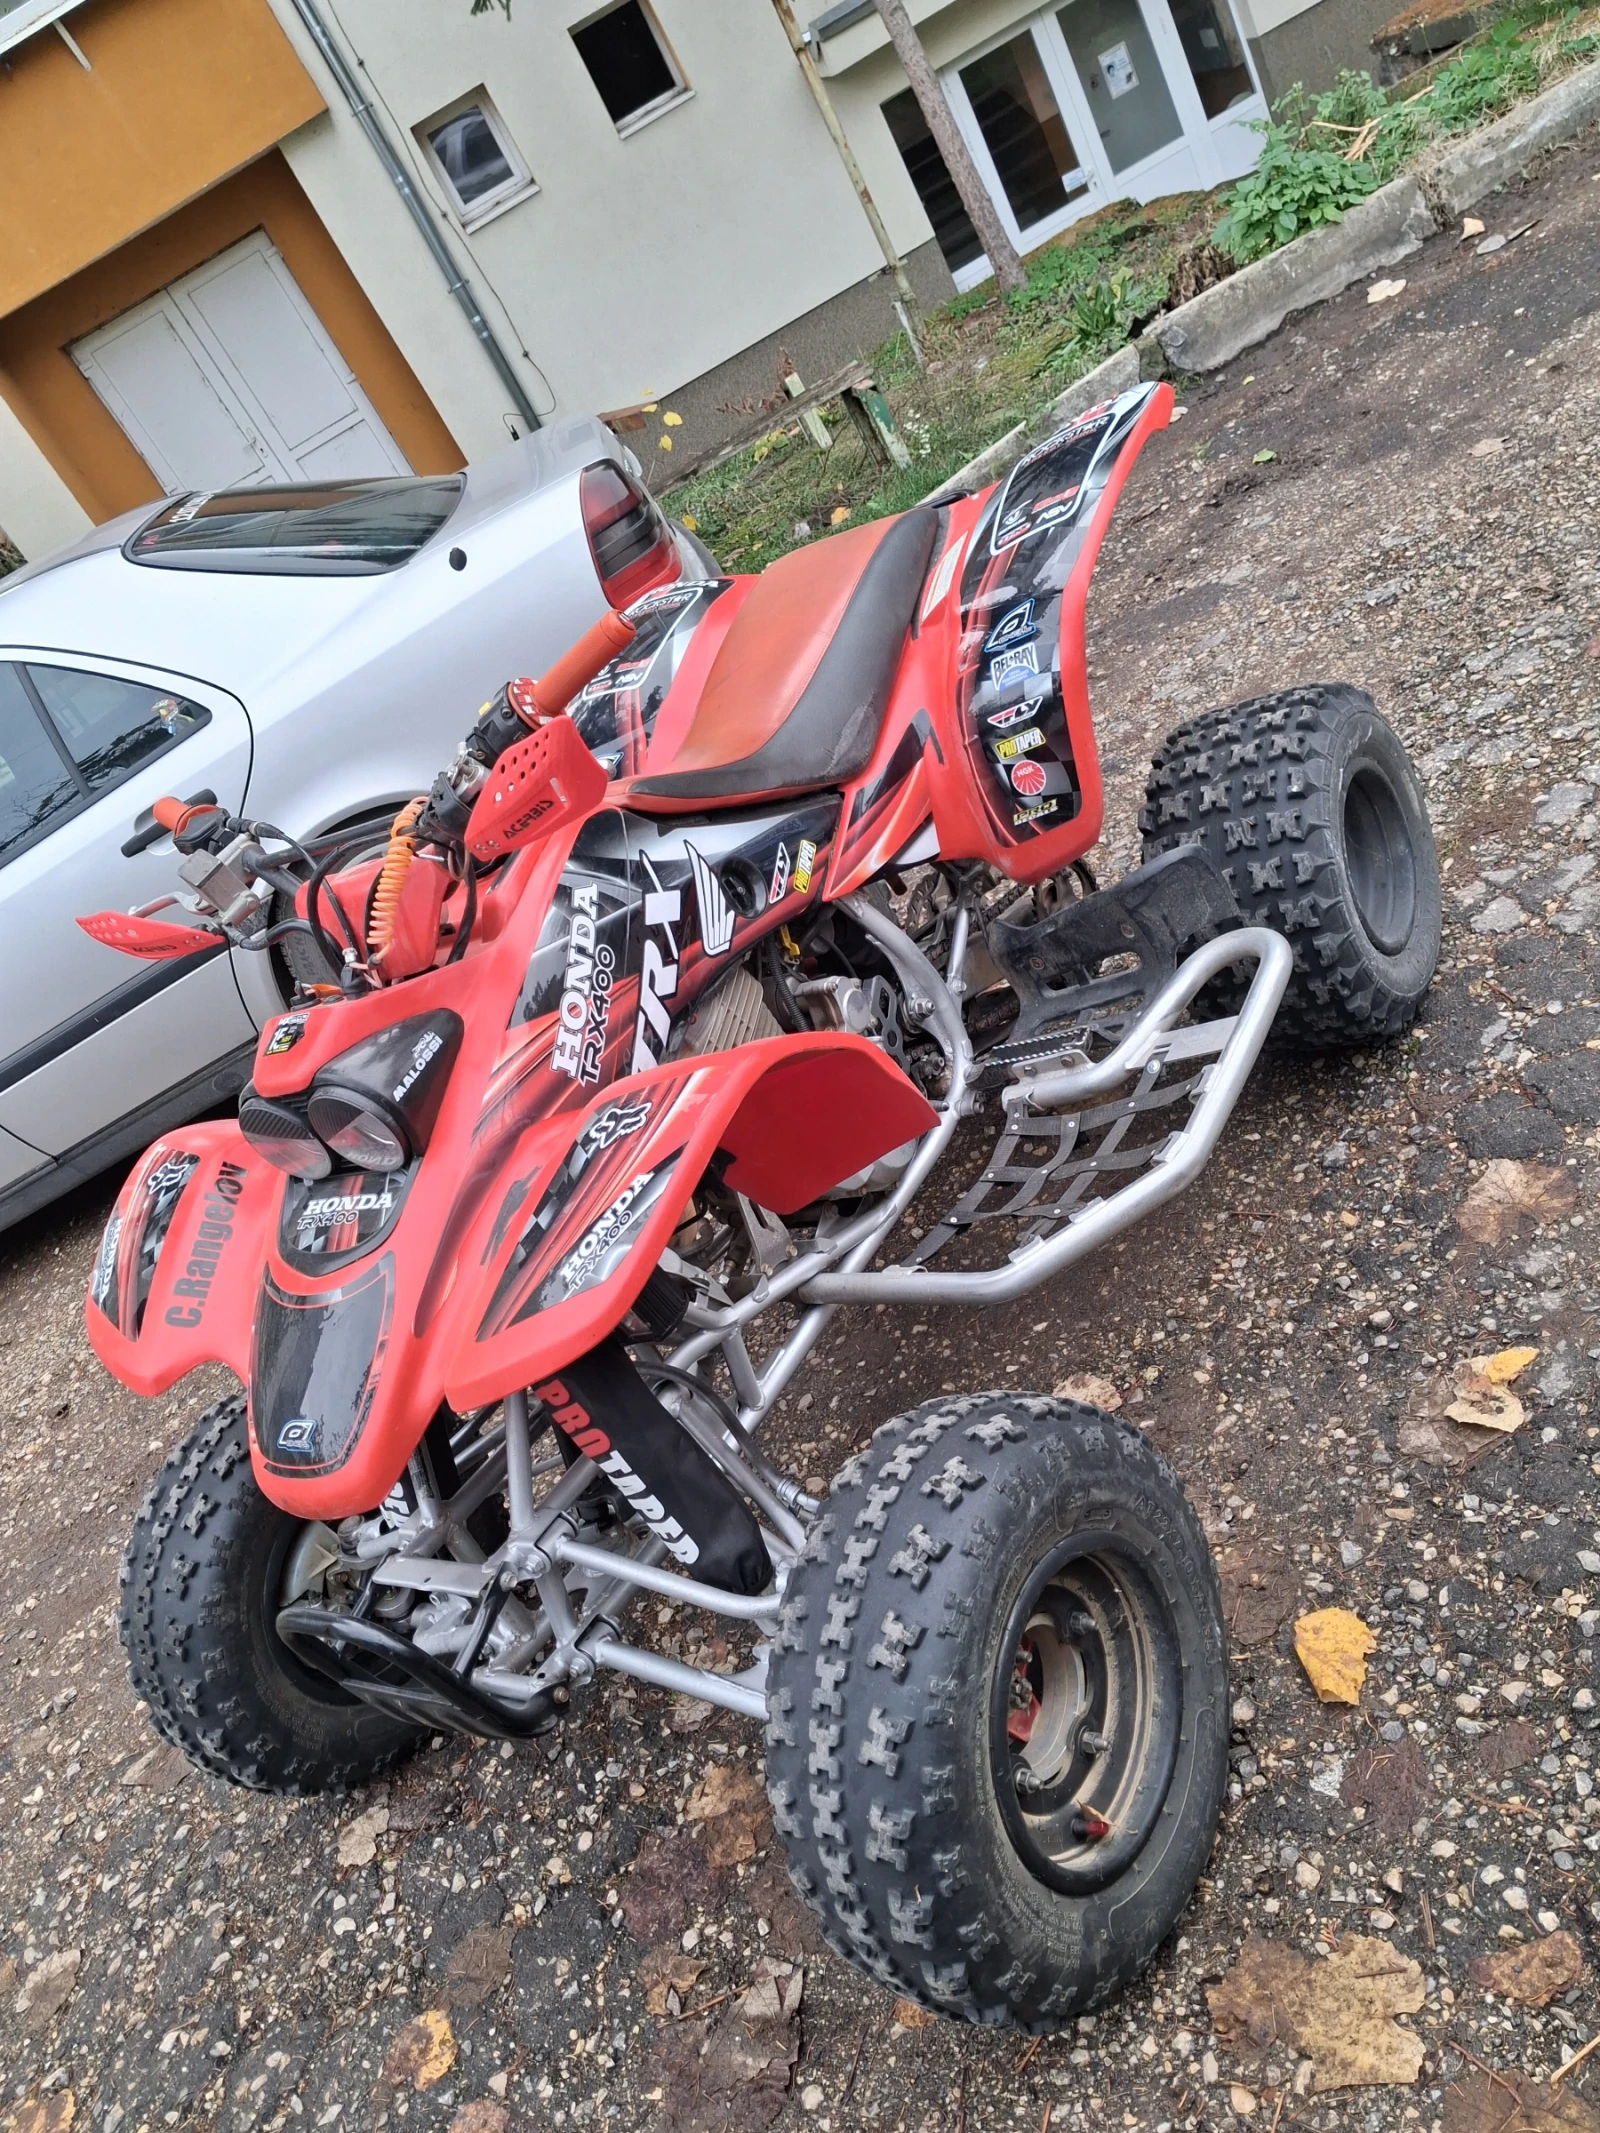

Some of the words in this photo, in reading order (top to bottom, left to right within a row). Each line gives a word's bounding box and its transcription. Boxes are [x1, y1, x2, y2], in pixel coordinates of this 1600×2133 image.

[998, 728, 1042, 758] PROTAPER
[1015, 765, 1035, 778] NGK
[502, 800, 554, 840] ACERBIS
[550, 881, 599, 1079] HONDA
[578, 943, 616, 1087] TRX400
[392, 1034, 444, 1103] MALOSSI
[296, 1210, 360, 1230] TRX400
[302, 1191, 393, 1216] HONDA
[560, 1170, 655, 1284] HONDA
[164, 1161, 249, 1329] C.Rangelov
[568, 1210, 634, 1291] TRX400
